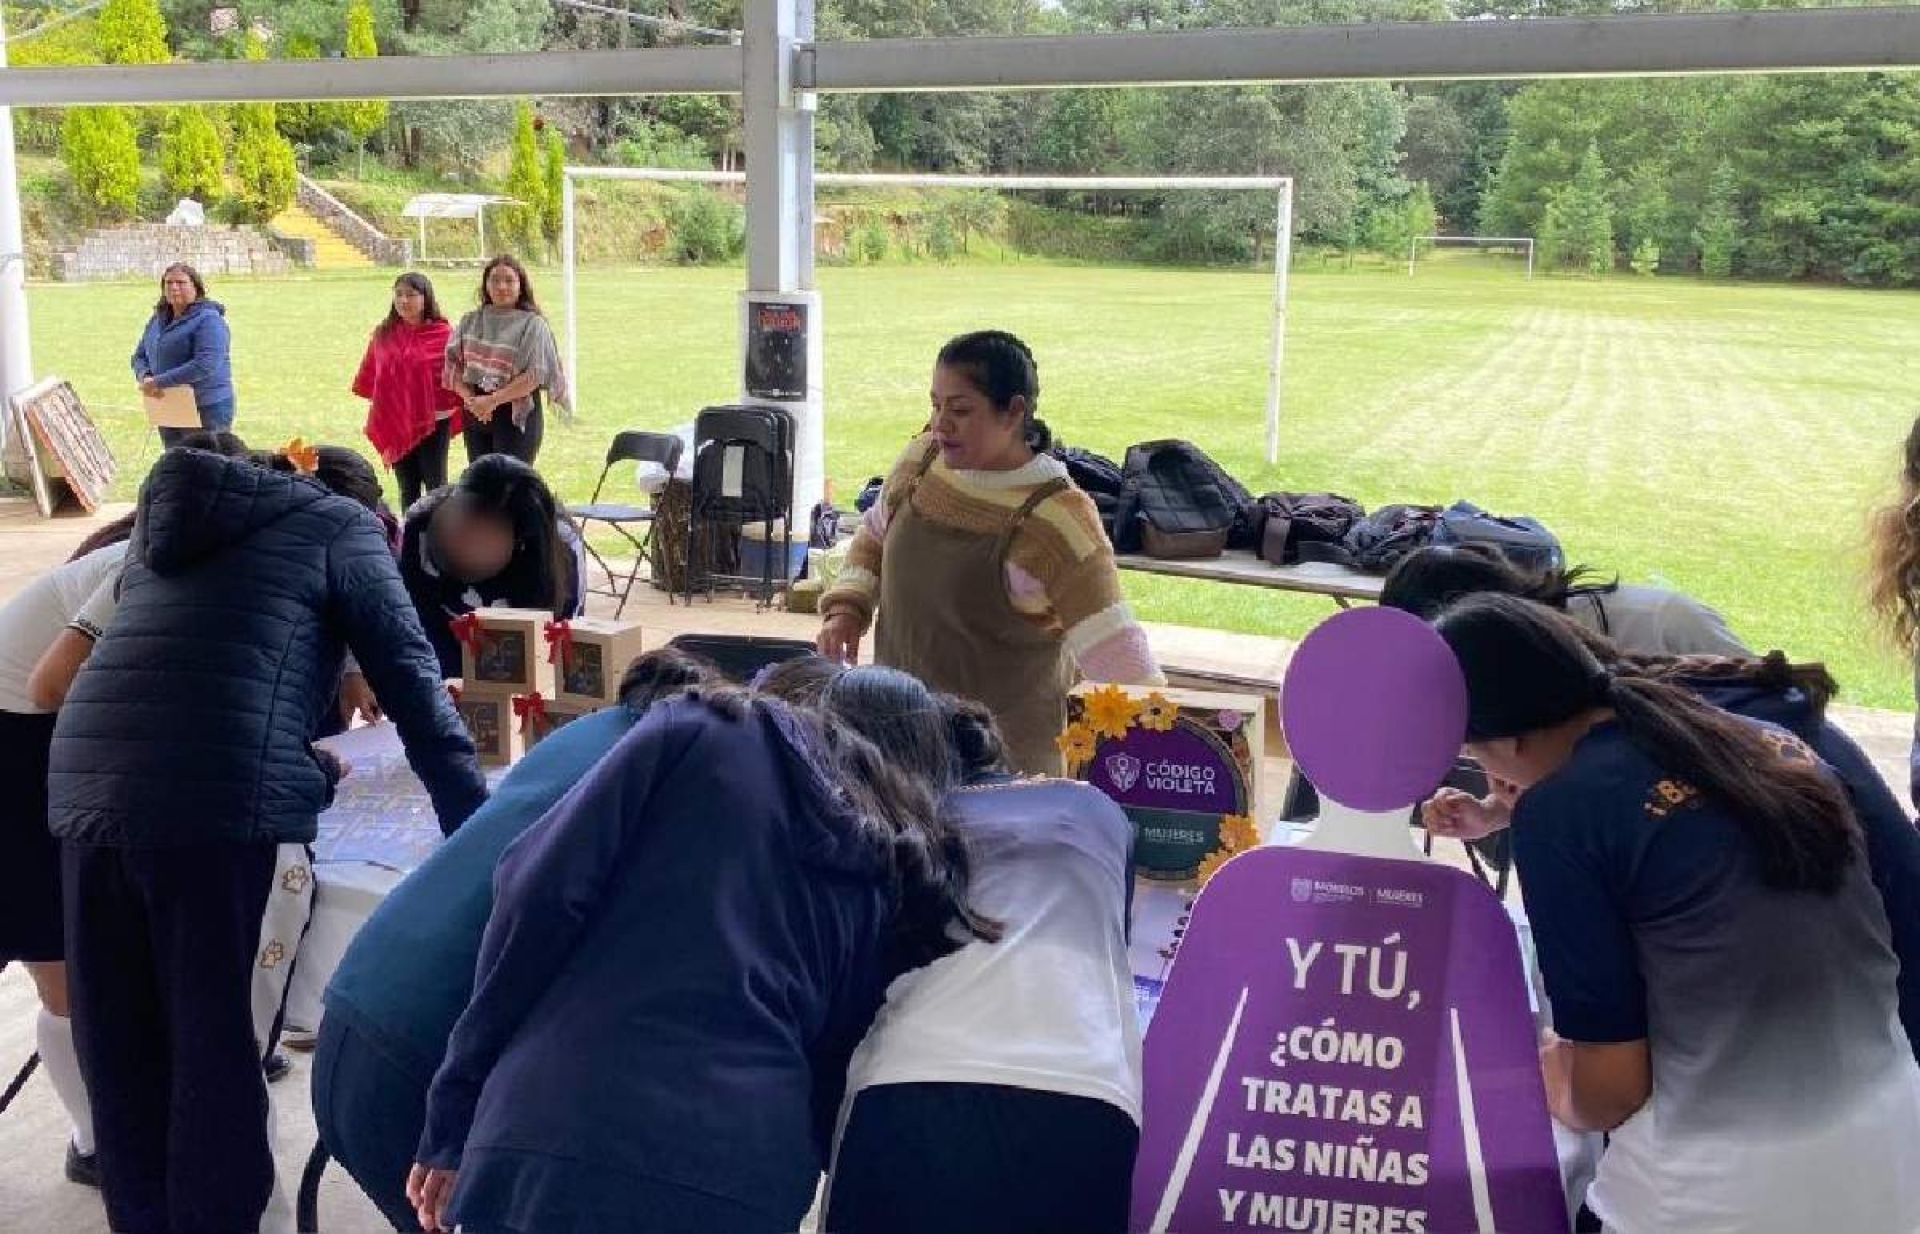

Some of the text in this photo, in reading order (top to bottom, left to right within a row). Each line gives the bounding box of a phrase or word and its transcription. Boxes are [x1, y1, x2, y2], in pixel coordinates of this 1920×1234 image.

[1145, 759, 1215, 781] CÓDIGO
[1145, 777, 1216, 795] VIOLETA
[1286, 932, 1420, 1010] Y TÚ,
[1270, 1017, 1404, 1069] ¿CÓMO
[1242, 1076, 1424, 1129] TRATAS A
[1226, 1132, 1429, 1186] LAS NIÑAS
[1217, 1188, 1428, 1234] Y MUJERES
